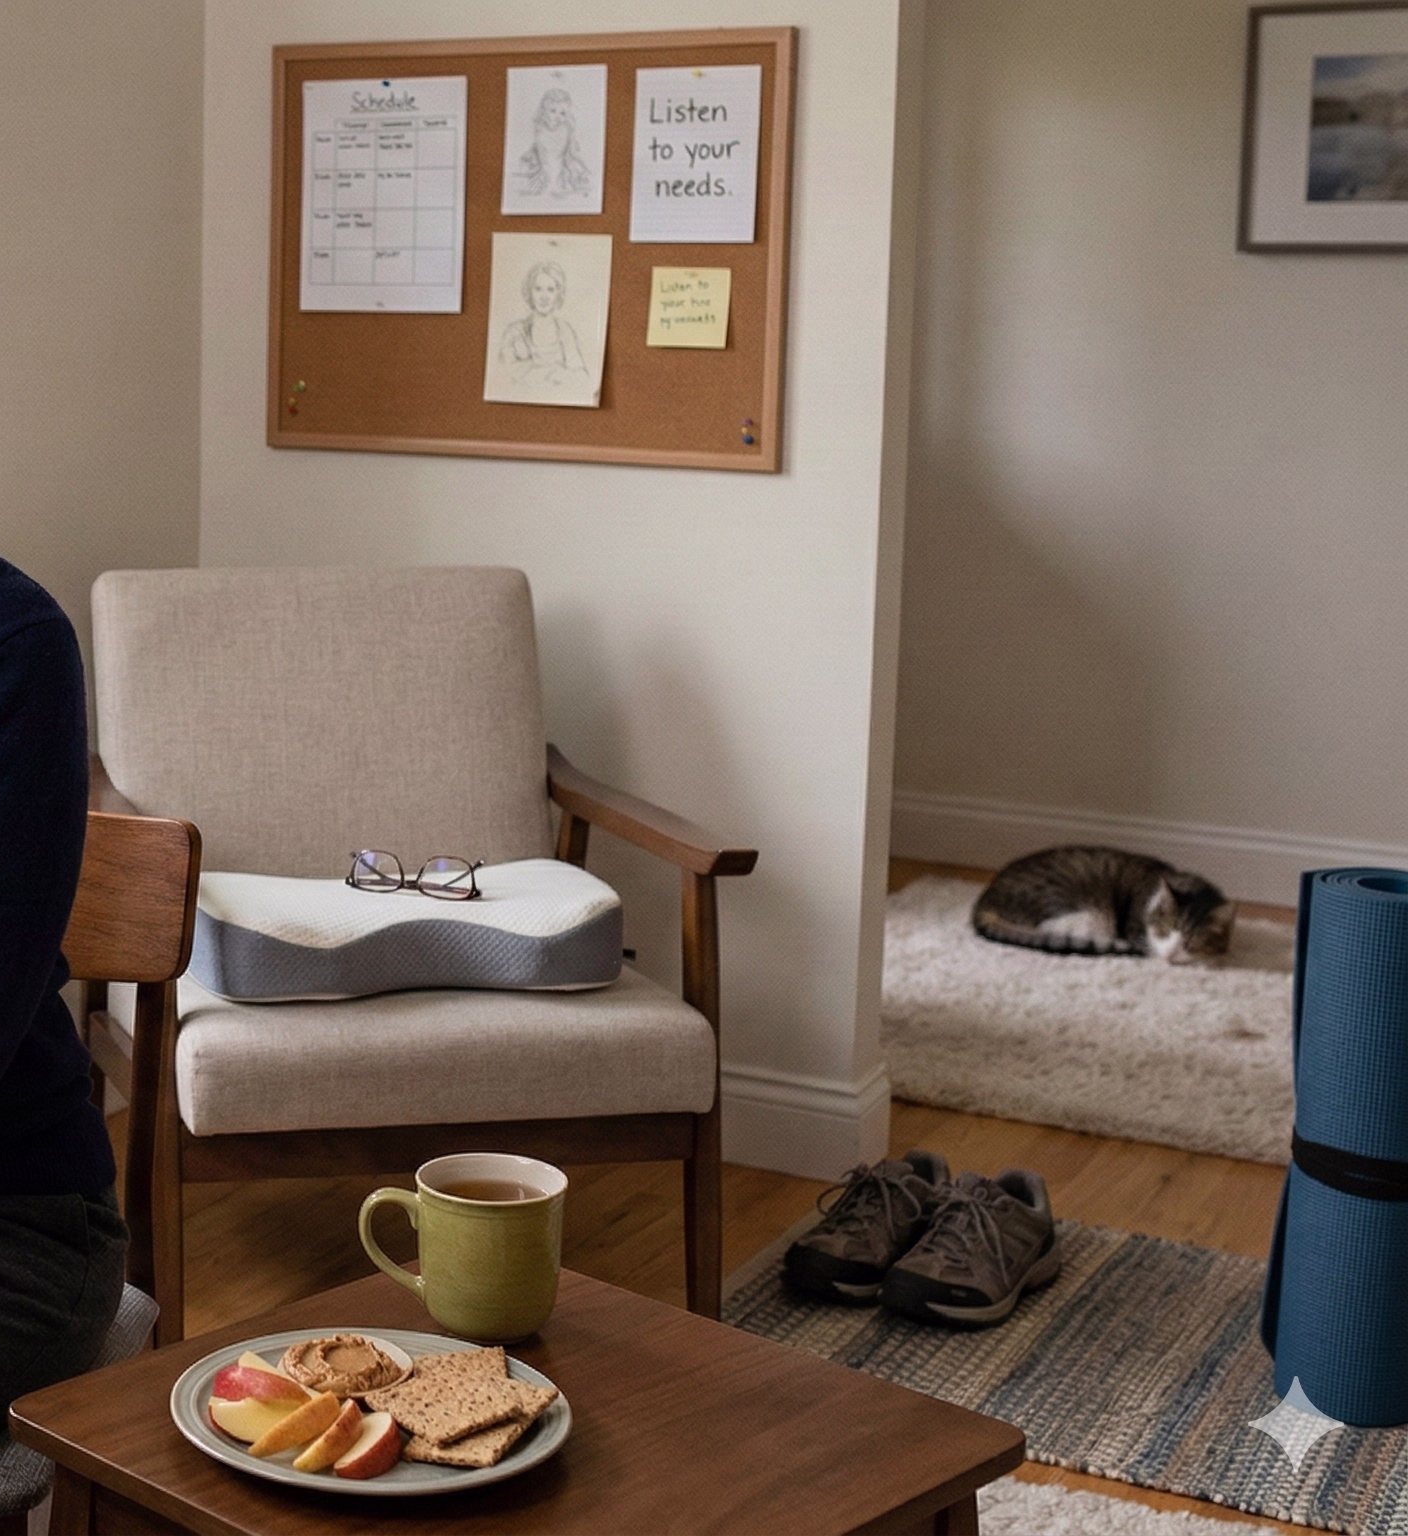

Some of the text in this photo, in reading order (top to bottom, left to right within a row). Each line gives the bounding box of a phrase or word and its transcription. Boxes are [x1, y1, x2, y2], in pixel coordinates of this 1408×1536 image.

[352, 91, 416, 109] Schedule
[649, 97, 728, 124] Listen
[648, 137, 741, 169] to your
[655, 171, 734, 197] needs.
